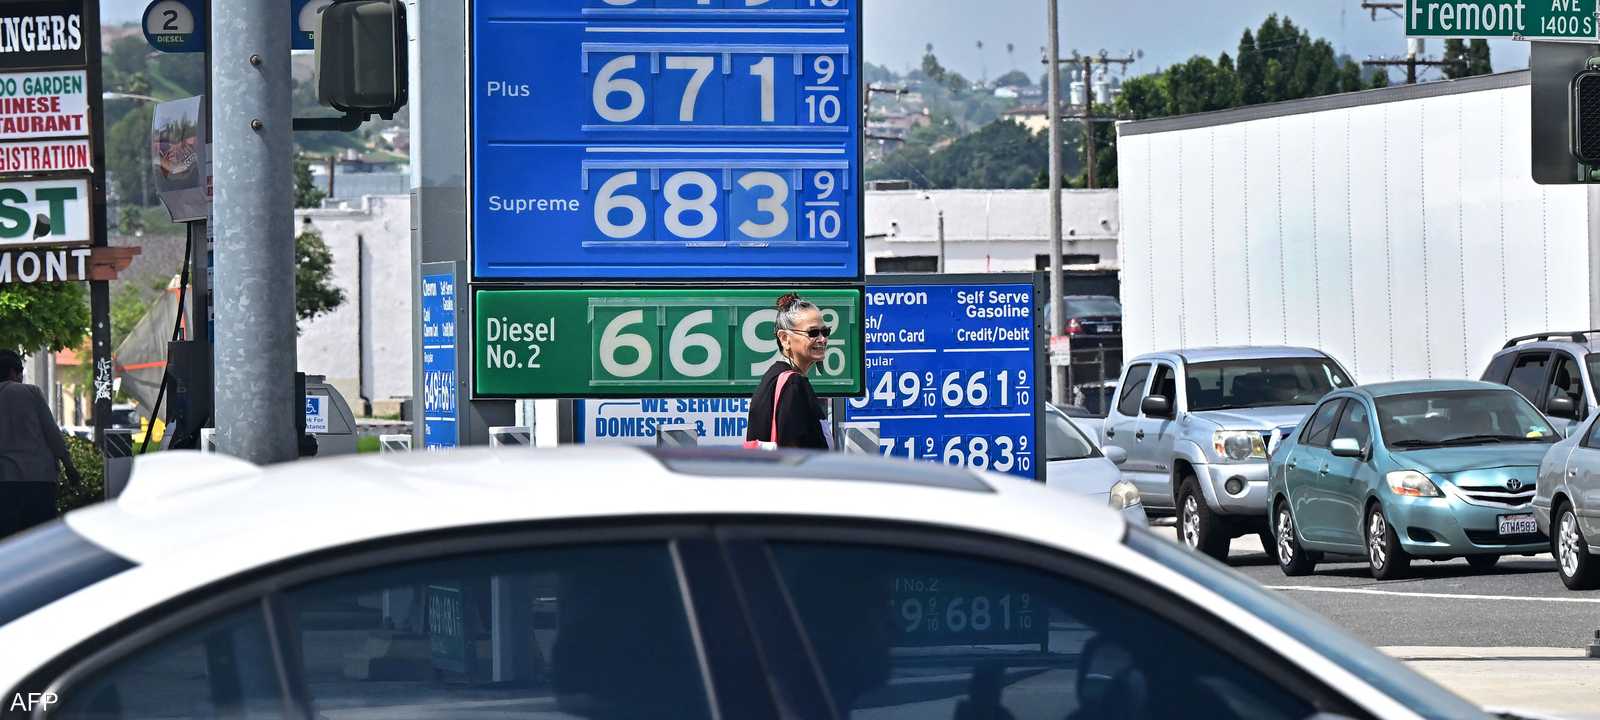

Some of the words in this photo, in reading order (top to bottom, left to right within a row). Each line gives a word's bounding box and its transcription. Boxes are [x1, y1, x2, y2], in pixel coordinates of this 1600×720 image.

[1551, 0, 1581, 12] AVE
[163, 10, 178, 31] 2
[1411, 0, 1526, 31] Fremont
[1541, 16, 1578, 34] 1400
[1583, 17, 1592, 34] S
[23, 76, 82, 96] GARDEN
[487, 82, 530, 97] Plus
[592, 55, 775, 122] 671
[489, 196, 580, 214] Supreme
[594, 171, 789, 238] 683
[957, 291, 984, 304] Self
[989, 291, 1029, 303] Serve
[966, 304, 1029, 317] Gasoline
[487, 317, 555, 342] Diesel
[899, 329, 925, 342] Card
[957, 326, 1030, 342] Credit/Debit
[942, 370, 1008, 407] 661
[641, 400, 668, 412] WE
[677, 400, 749, 412] SERVICE
[944, 436, 1014, 472] 683
